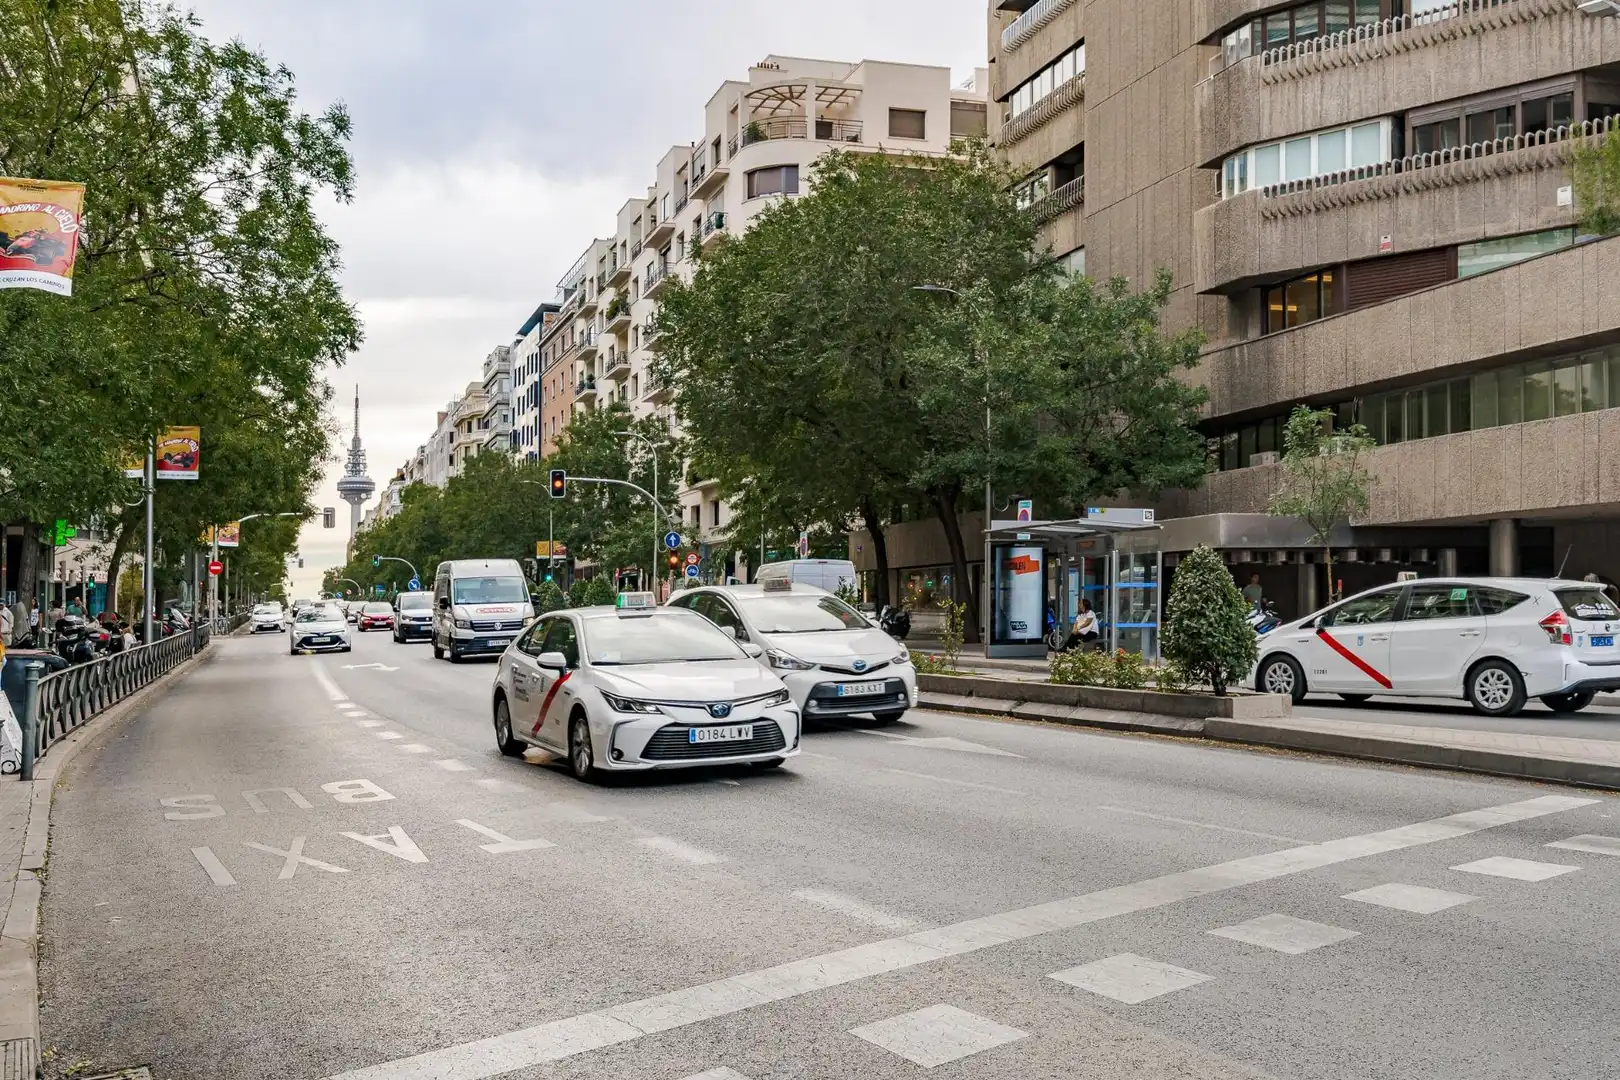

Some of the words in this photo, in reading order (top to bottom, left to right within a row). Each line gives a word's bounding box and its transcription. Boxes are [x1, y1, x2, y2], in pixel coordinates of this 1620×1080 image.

[41, 205, 56, 214] AL
[55, 209, 80, 233] CIELO
[38, 278, 65, 290] CAMINOS
[698, 728, 726, 740] 0184
[160, 778, 397, 820] BUS
[191, 819, 558, 886] TAXI
